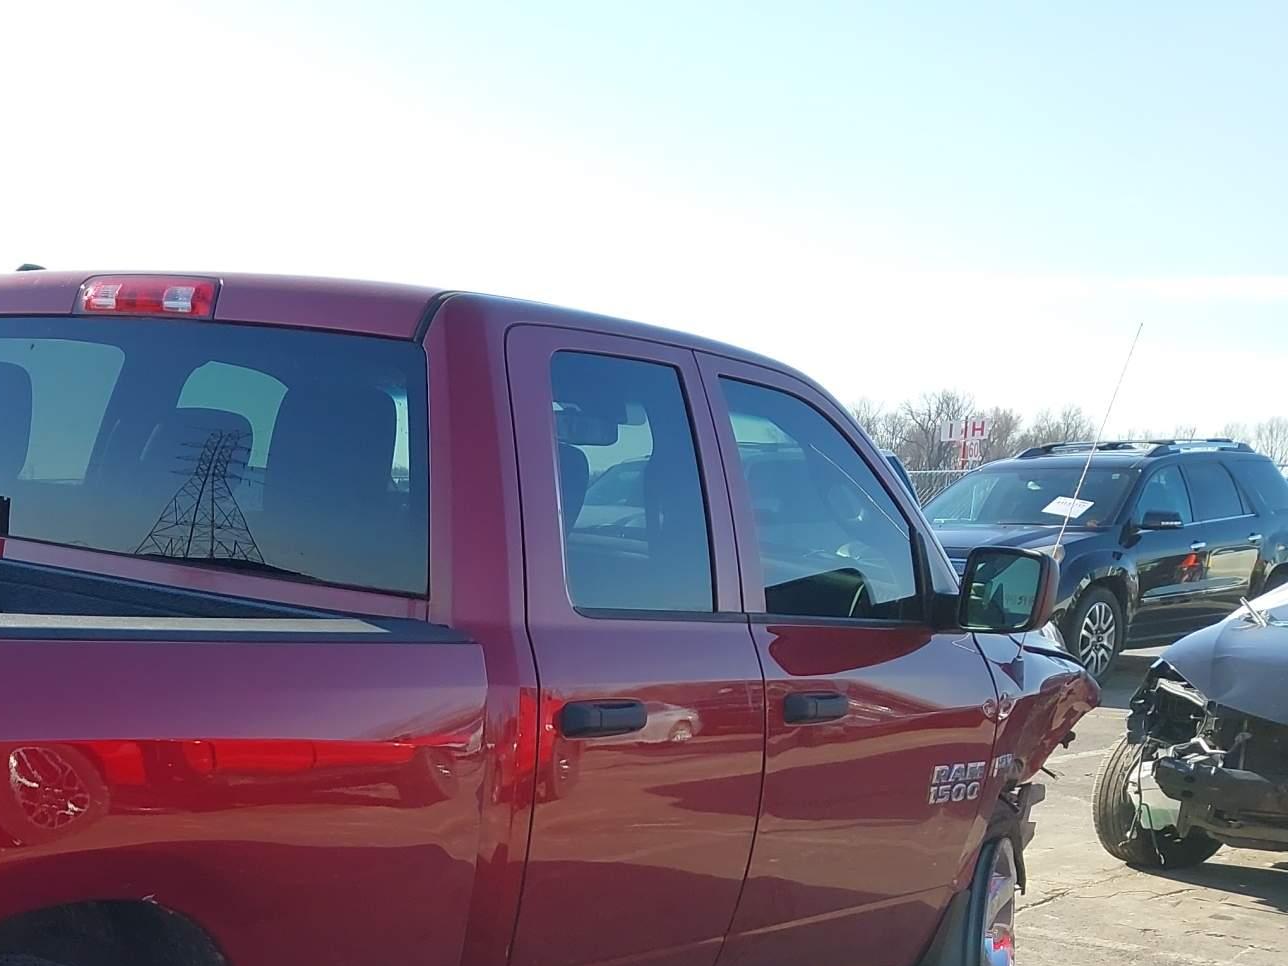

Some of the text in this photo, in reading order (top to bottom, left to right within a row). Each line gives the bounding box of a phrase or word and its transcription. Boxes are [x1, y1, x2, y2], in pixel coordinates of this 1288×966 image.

[972, 421, 985, 437] H
[932, 761, 986, 784] RAM
[928, 782, 980, 804] 1500
